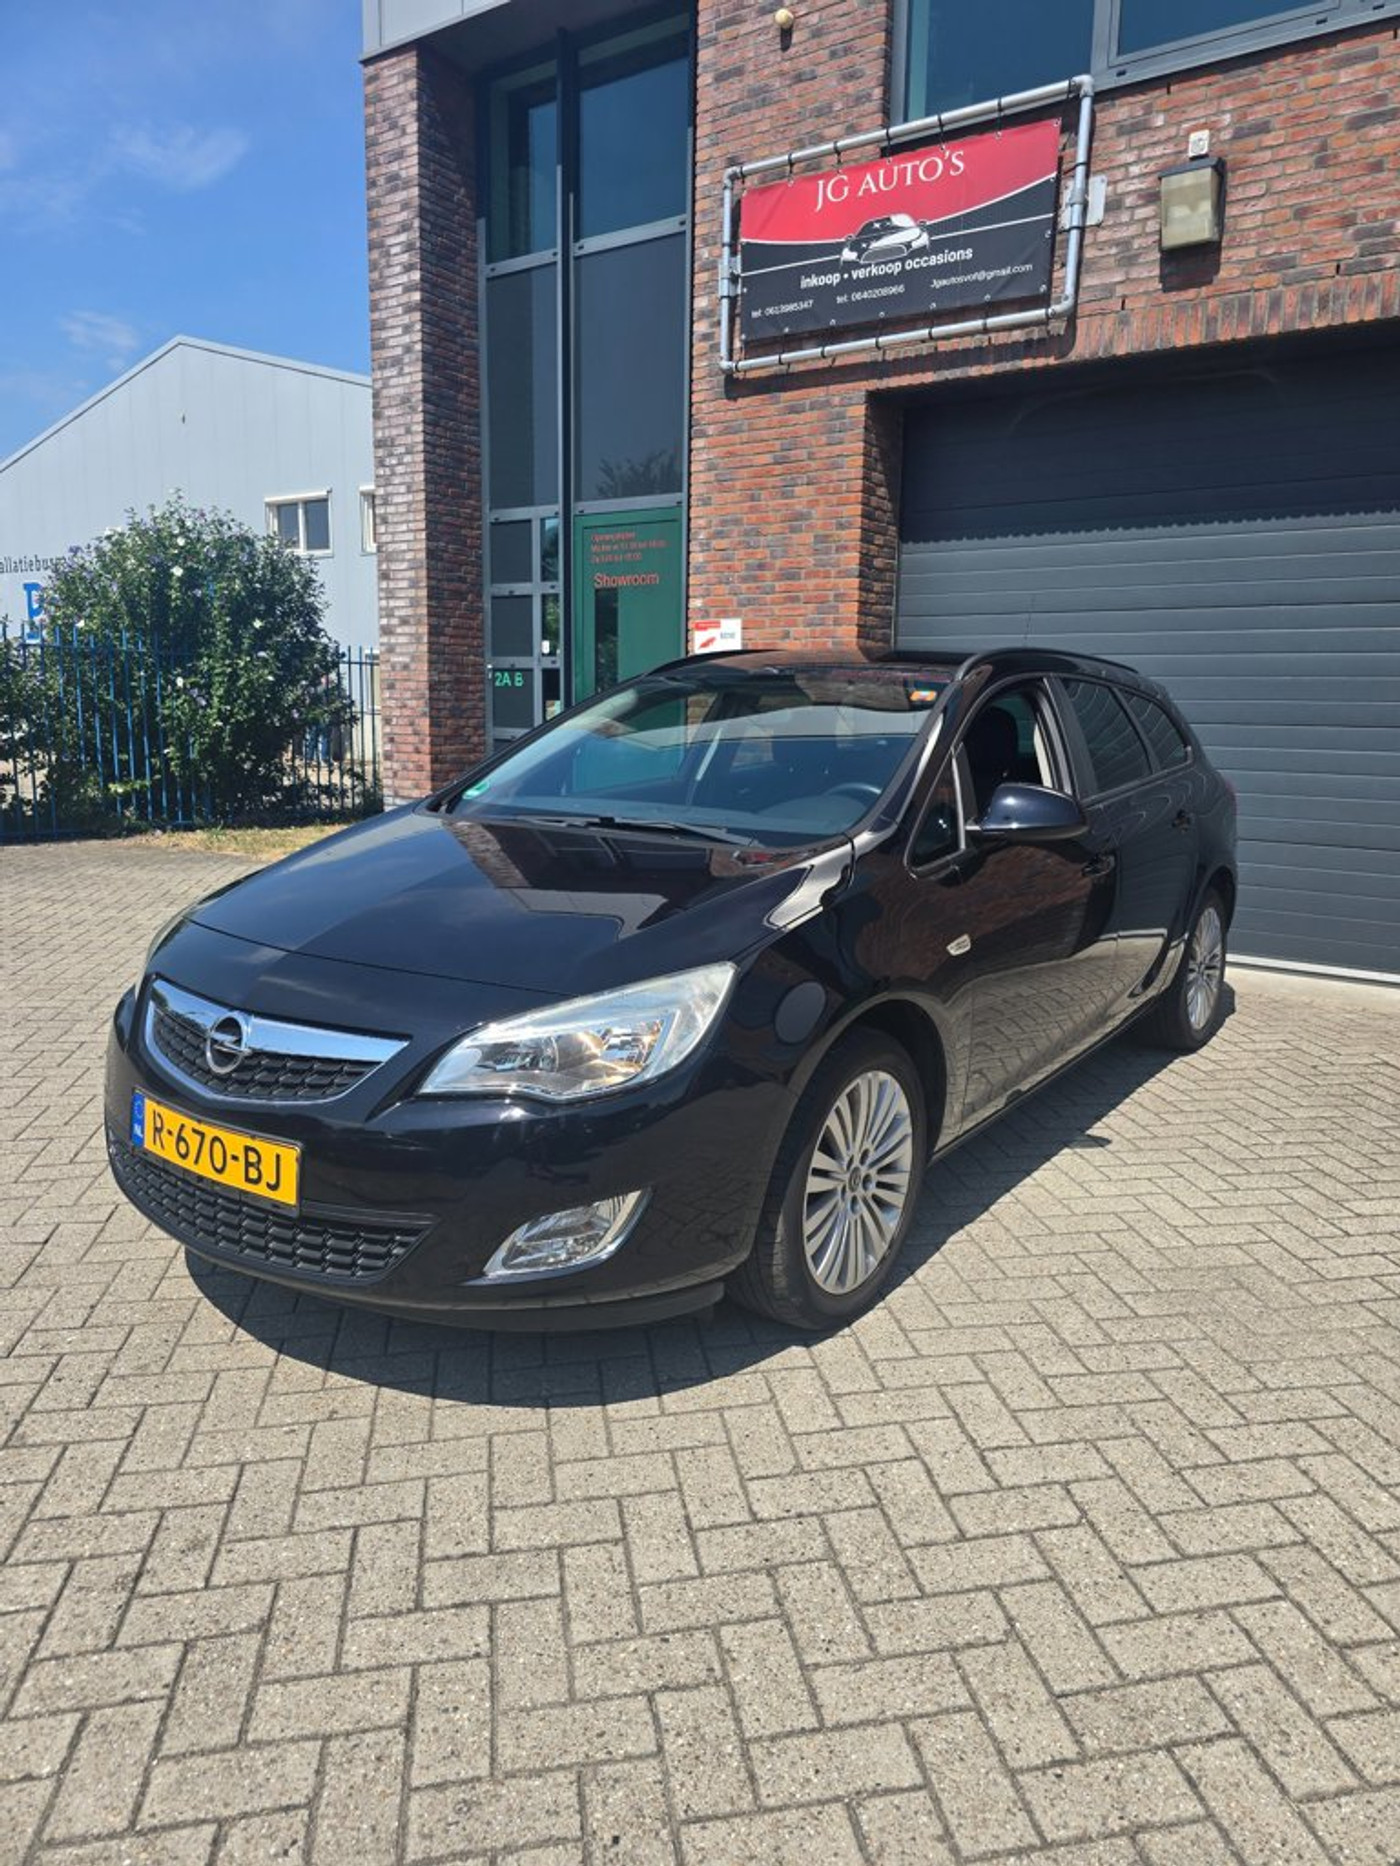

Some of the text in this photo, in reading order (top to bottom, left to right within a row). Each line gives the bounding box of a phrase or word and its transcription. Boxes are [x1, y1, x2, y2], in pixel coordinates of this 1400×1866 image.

[815, 150, 965, 213] JG AUTO'S
[800, 248, 973, 289] inkoop verkoop occasions
[594, 572, 659, 588] Showroom
[494, 671, 512, 687] 2A
[153, 1110, 281, 1192] R-670-BJ
